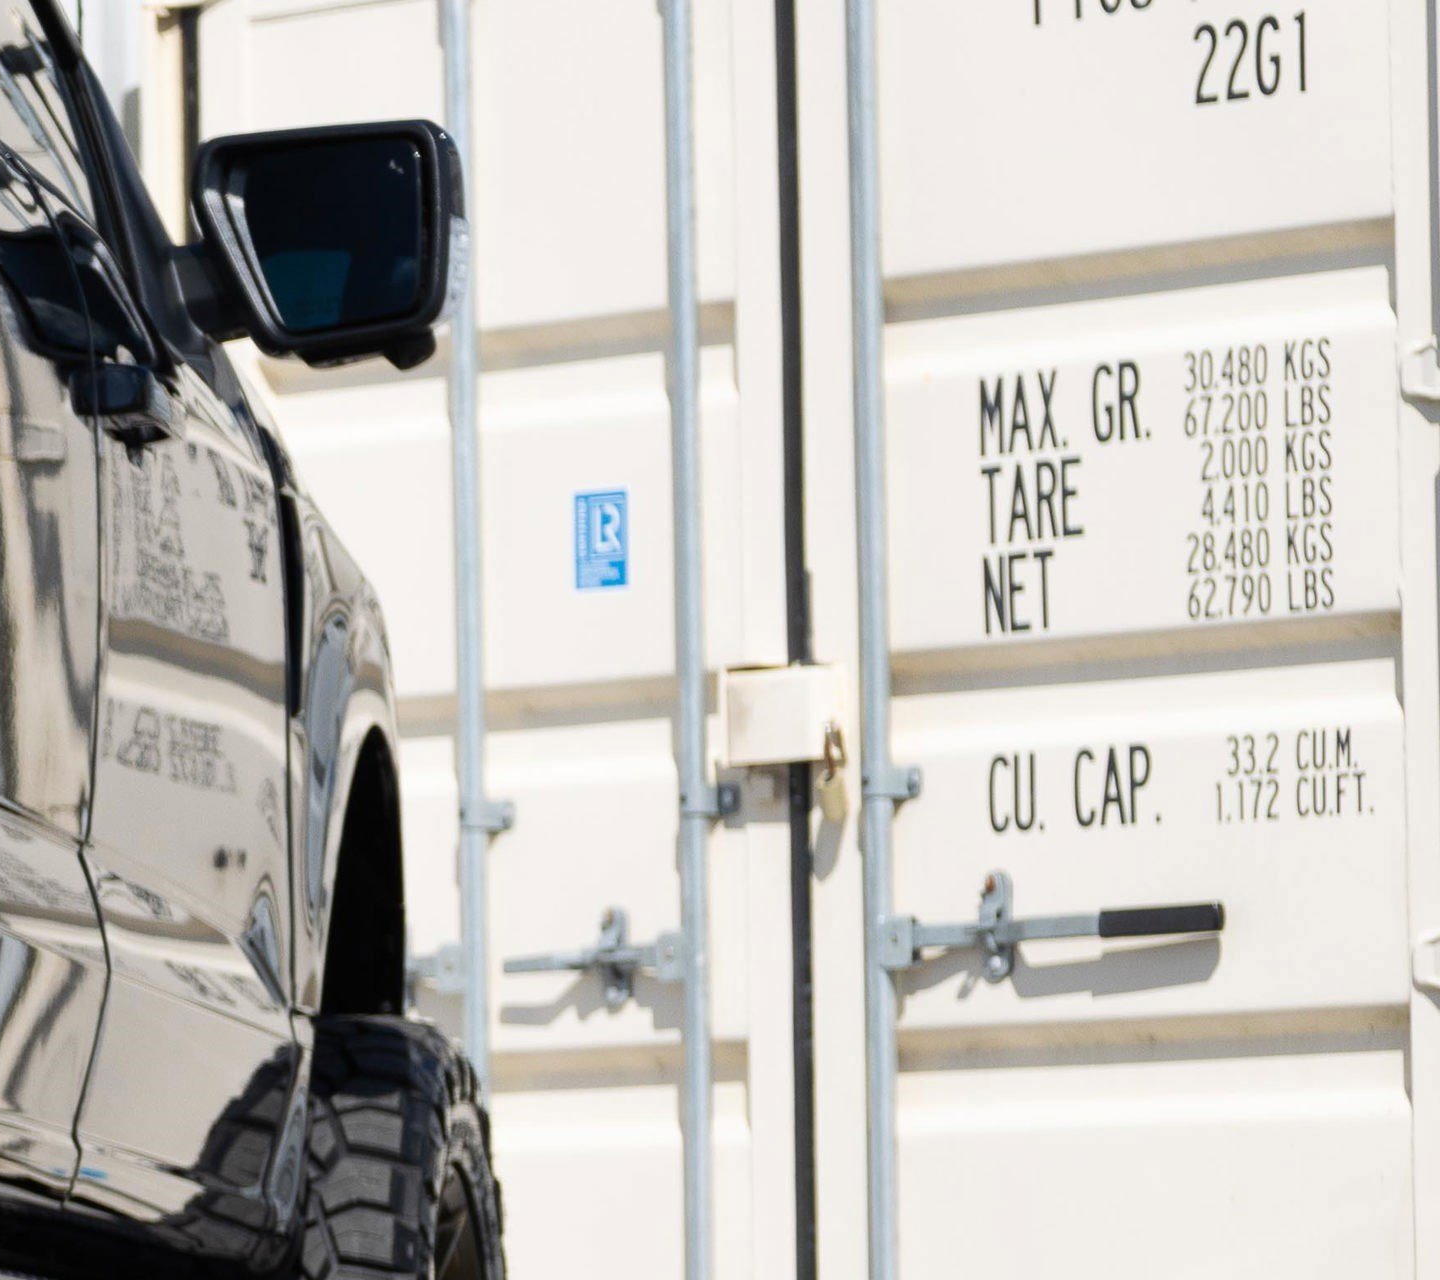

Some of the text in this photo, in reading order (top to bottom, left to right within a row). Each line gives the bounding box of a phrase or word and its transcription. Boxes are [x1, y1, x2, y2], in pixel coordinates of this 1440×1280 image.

[1193, 11, 1307, 105] 22G1
[1184, 337, 1331, 392] 30.480 KGS
[979, 359, 1152, 456] MAX. GR.
[1184, 384, 1331, 438] 67.200 LBS
[1200, 430, 1331, 482] 2.000 KGS
[981, 456, 1084, 545] TARE
[1201, 476, 1332, 526] 4.410 LBS
[1187, 522, 1333, 573] 28.480 KGS
[982, 550, 1055, 635] NET
[1188, 567, 1335, 618] 62.790 LBS
[1227, 727, 1358, 776] 33.2 CU.M.
[988, 743, 1162, 835] CU. CAP.
[1216, 771, 1375, 822] 1.172 CU.FT.
